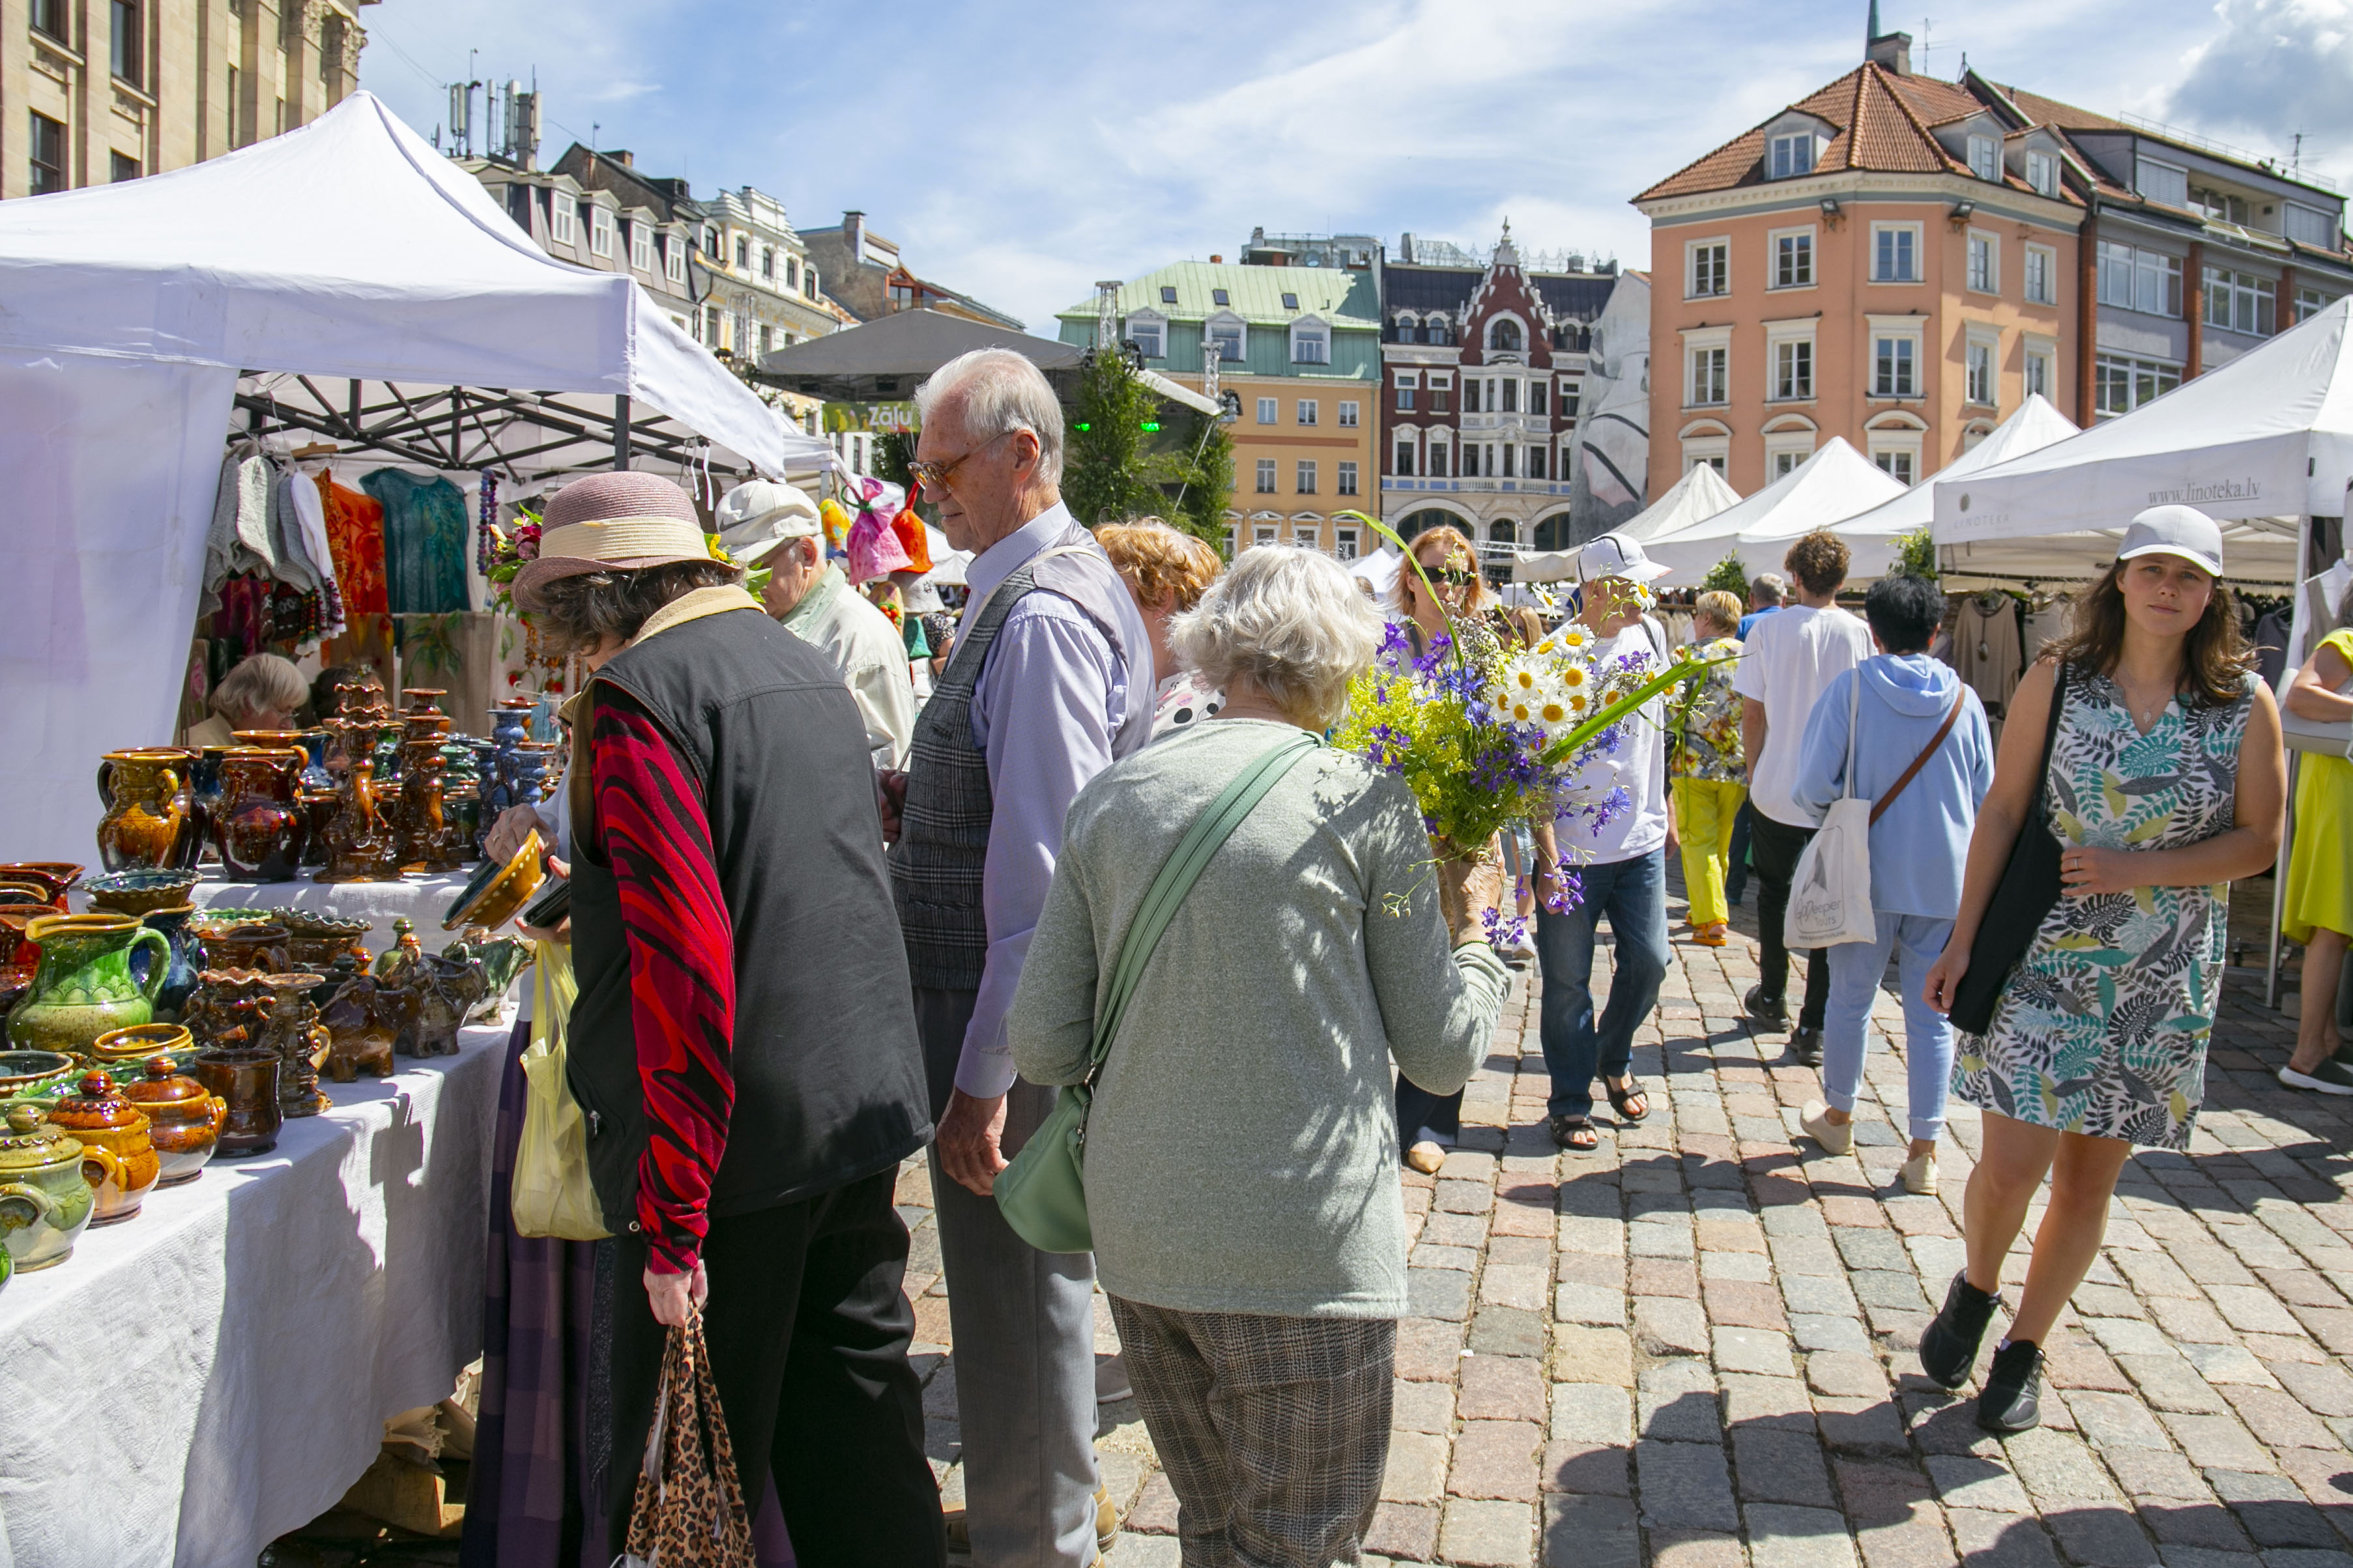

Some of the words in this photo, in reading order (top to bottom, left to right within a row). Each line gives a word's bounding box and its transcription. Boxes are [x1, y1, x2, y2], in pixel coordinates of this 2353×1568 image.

[868, 406, 912, 431] Zāļu
[2148, 477, 2261, 504] www.linoteka.lv
[1954, 515, 2010, 529] LINOTEKA
[1814, 917, 1836, 927] Tours
